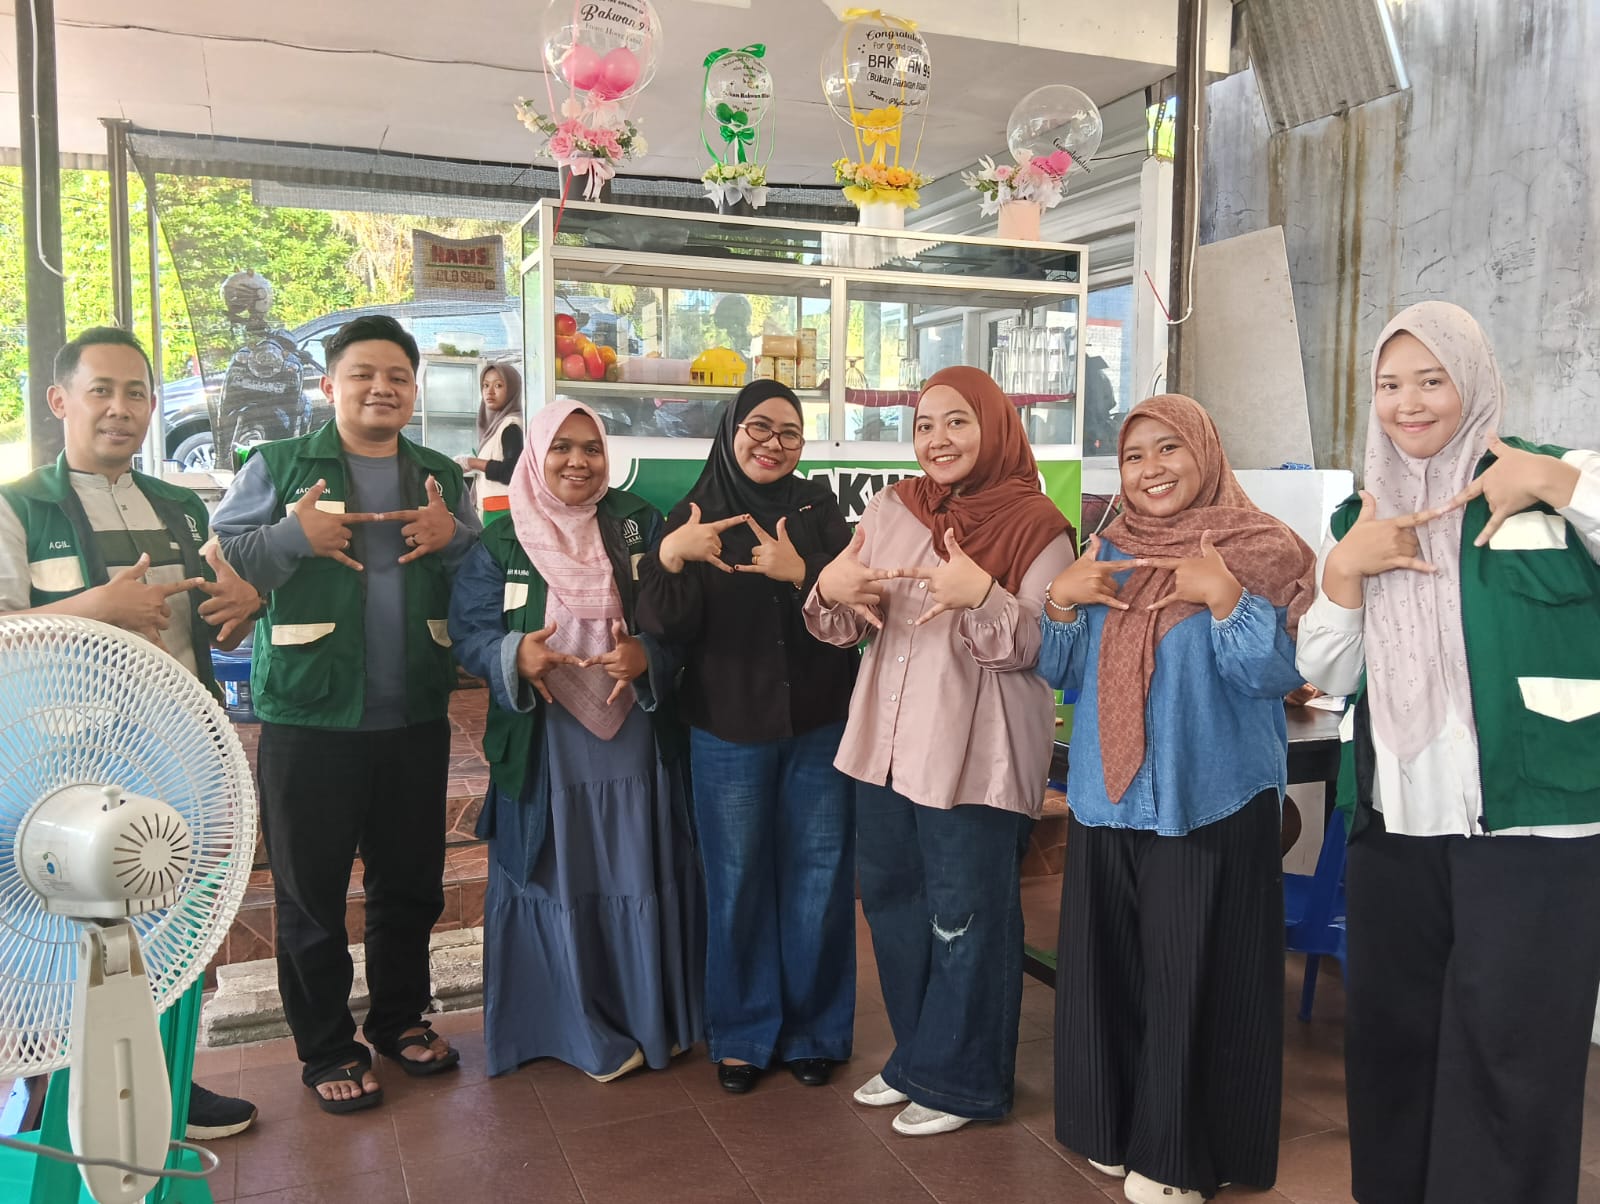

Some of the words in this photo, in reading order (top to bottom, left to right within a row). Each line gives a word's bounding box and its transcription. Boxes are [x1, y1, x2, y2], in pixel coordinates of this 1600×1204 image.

[581, 4, 634, 28] Bakwan
[868, 54, 922, 75] BAKAN
[867, 72, 892, 85] (Bukan
[431, 245, 488, 265] HABIS
[436, 270, 485, 283] CLOSED
[49, 540, 72, 551] AGIL
